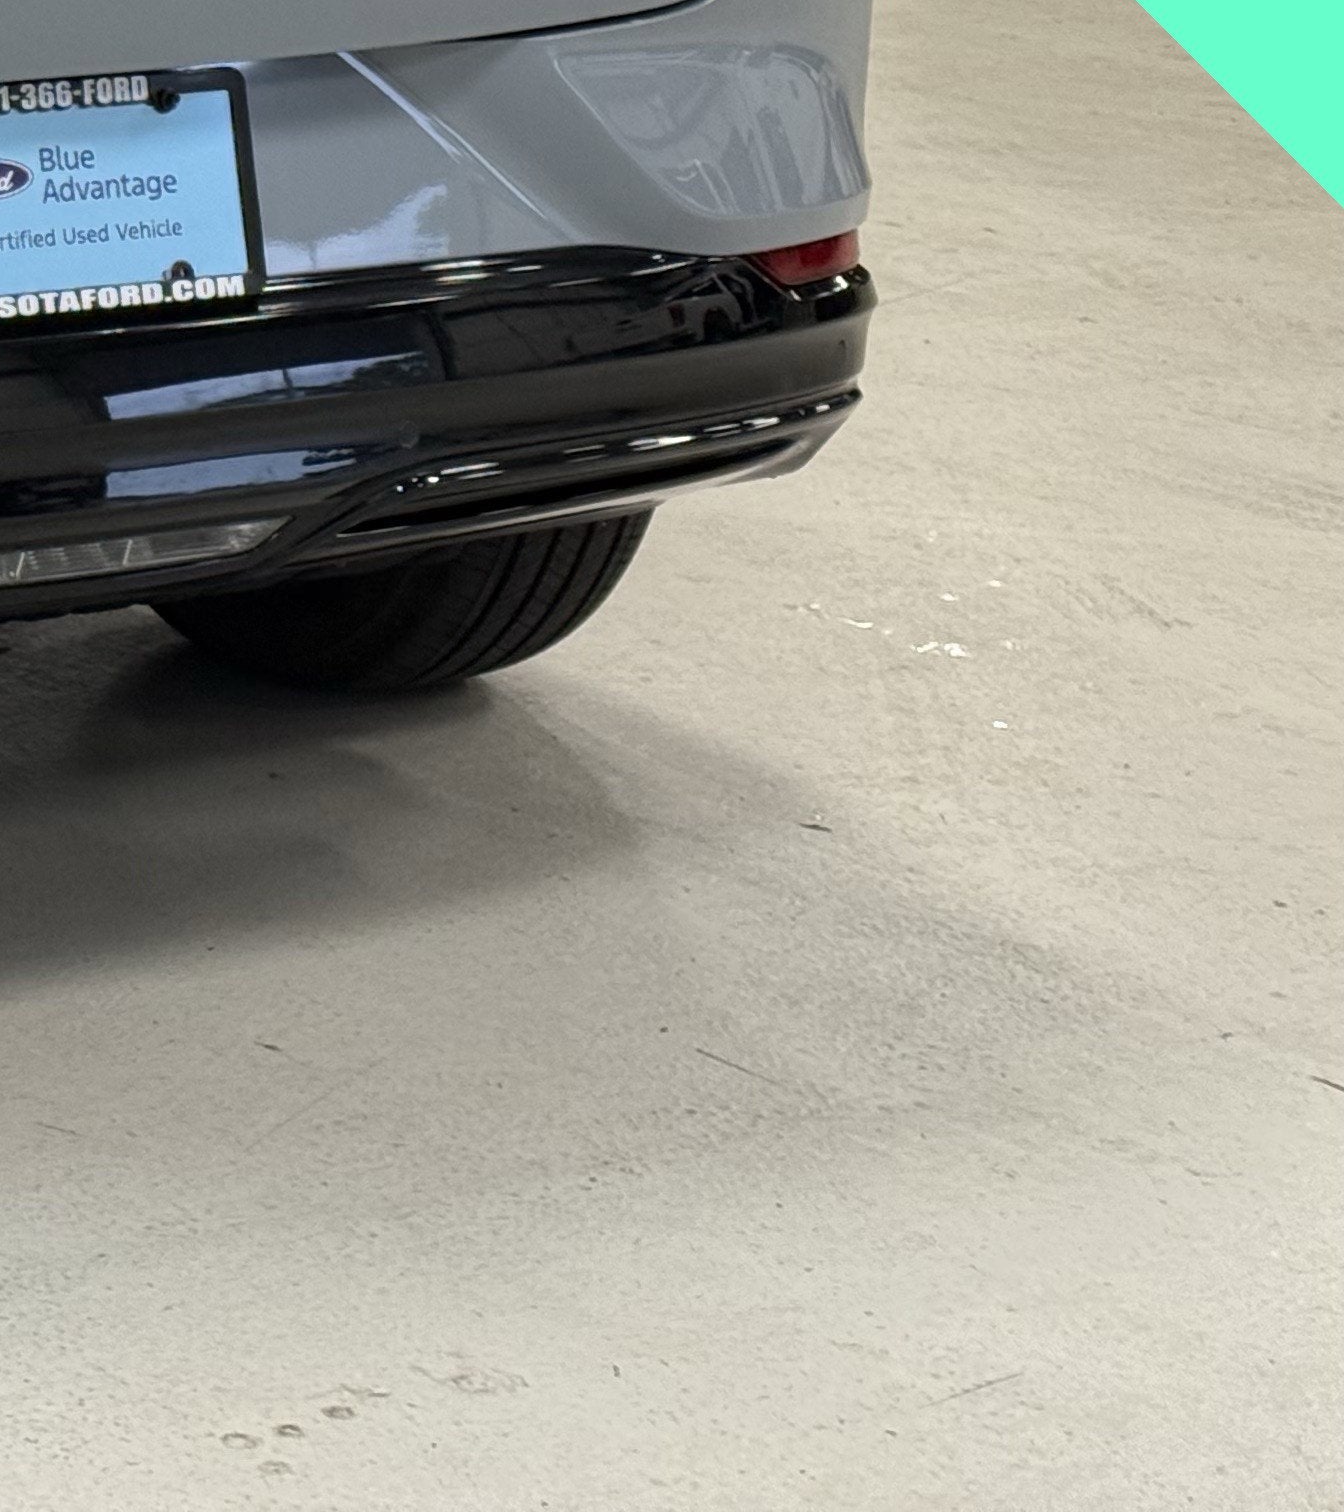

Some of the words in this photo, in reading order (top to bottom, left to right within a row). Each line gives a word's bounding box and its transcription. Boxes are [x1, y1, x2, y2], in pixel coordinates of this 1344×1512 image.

[38, 145, 95, 173] Blue
[41, 171, 178, 205] Advantage
[61, 223, 110, 246] Used
[115, 218, 184, 243] Vehicle
